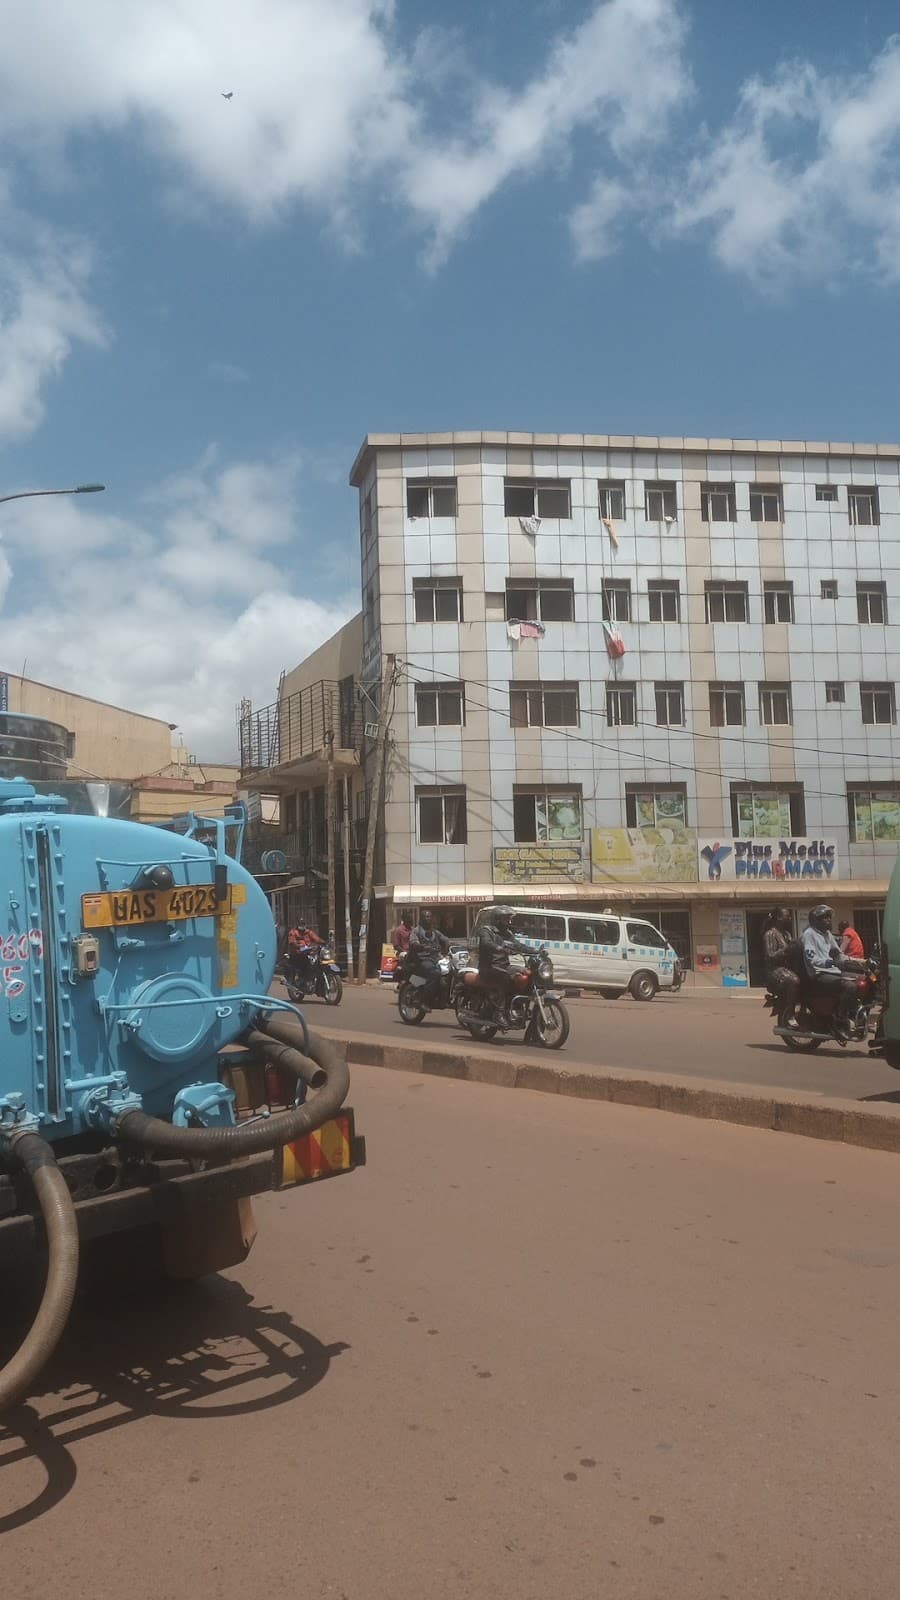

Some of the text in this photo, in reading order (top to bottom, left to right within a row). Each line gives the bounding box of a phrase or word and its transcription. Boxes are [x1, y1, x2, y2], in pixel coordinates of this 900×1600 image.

[735, 841, 835, 858] Plus Medic
[735, 860, 835, 878] PHARMACY
[113, 892, 156, 921] UAS
